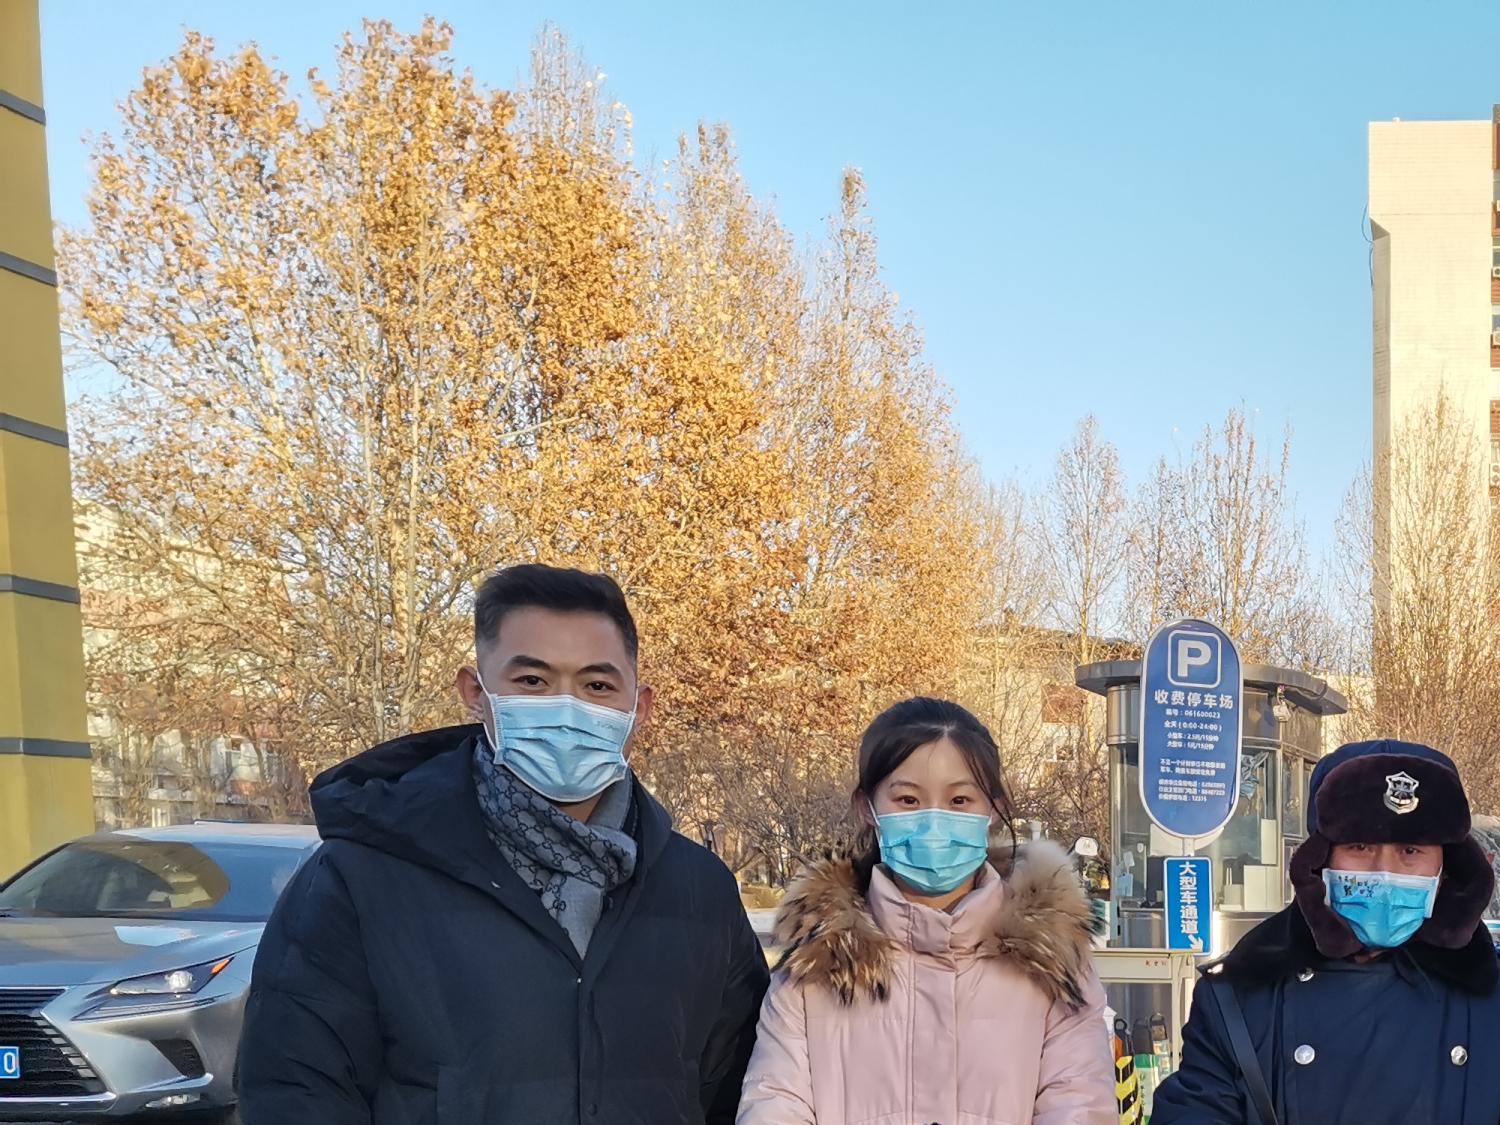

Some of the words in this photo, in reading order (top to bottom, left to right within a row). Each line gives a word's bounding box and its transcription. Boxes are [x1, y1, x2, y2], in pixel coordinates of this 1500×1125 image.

[1177, 639, 1212, 677] P
[1154, 689, 1233, 709] 收费停车场
[1179, 861, 1199, 934] 大型车通道
